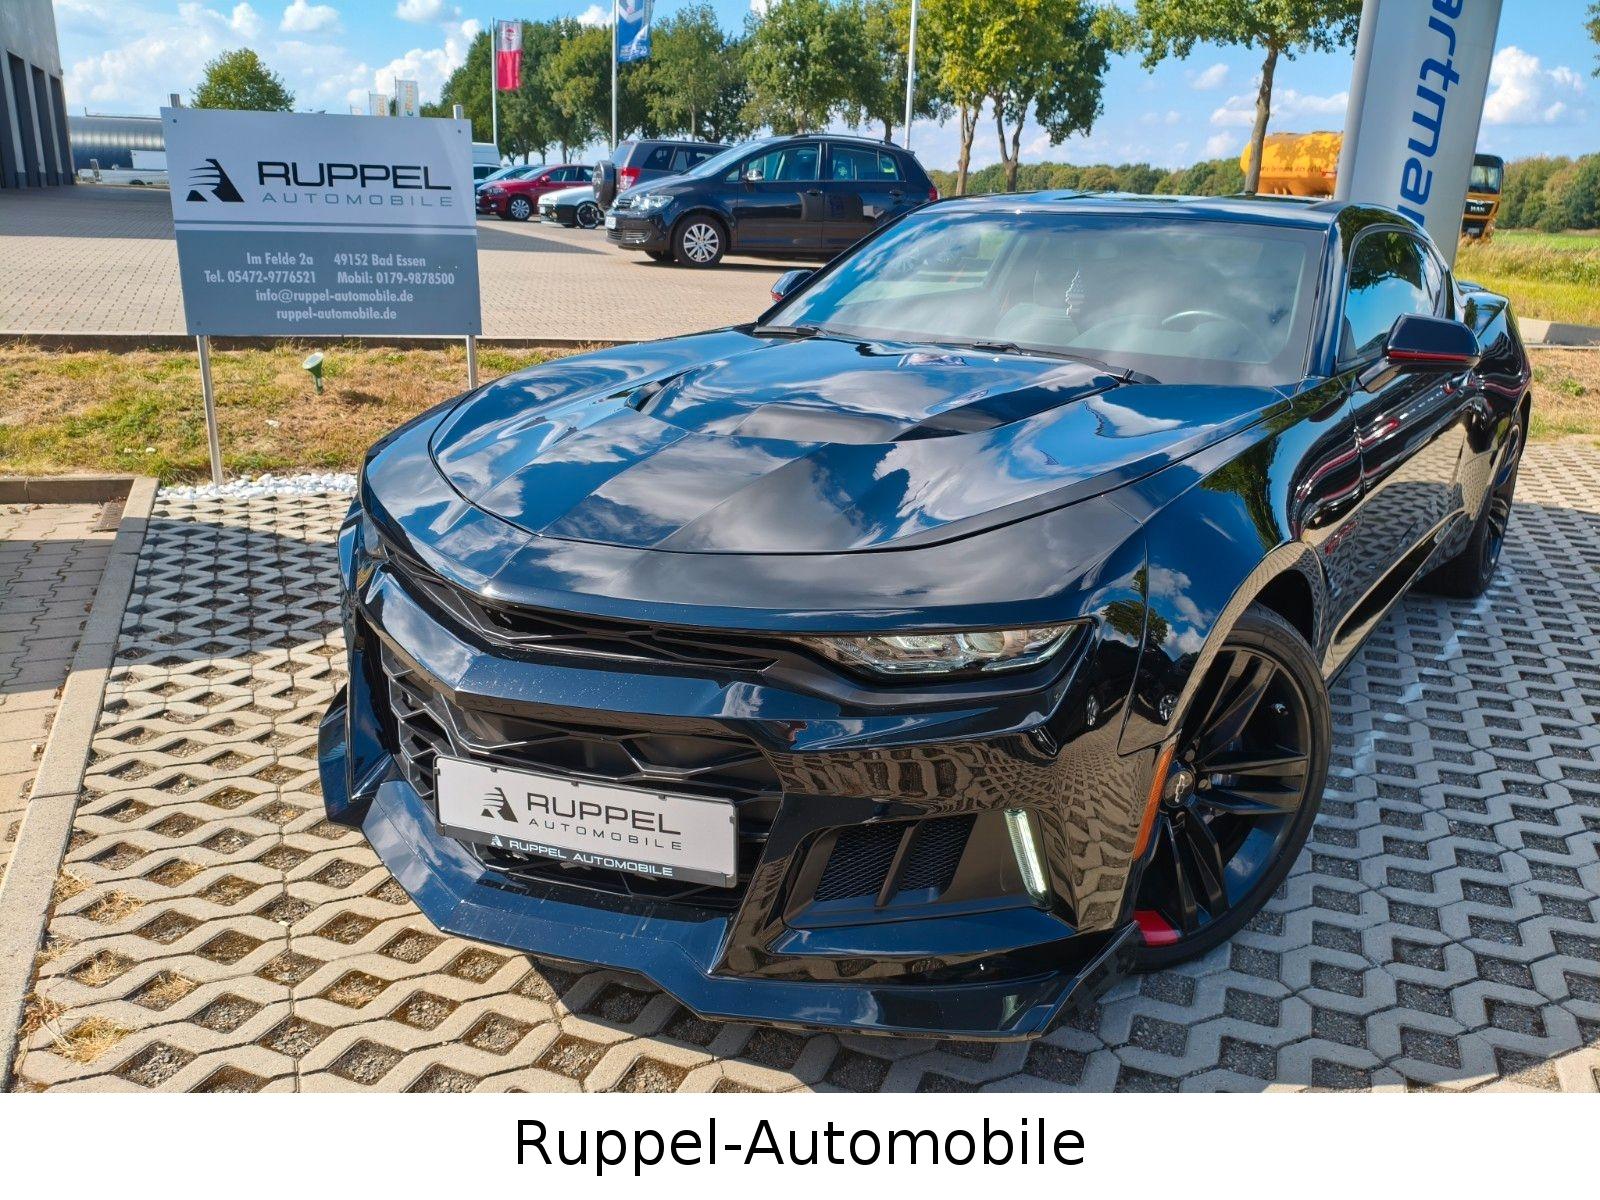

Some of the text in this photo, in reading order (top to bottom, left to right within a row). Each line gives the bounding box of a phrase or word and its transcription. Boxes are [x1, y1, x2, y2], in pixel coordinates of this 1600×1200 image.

[257, 161, 452, 190] RUPPEL
[262, 192, 453, 207] AUTOMOBILE
[246, 252, 426, 267] Im Felde 2a 49152 Bad Essen
[204, 269, 455, 284] Tel. 05472-9776521 Mobil: 0179-9878500
[255, 288, 414, 304] info@ruppel-automobile.de
[276, 306, 397, 322] ruppel-automobile.de
[526, 792, 682, 835] RUPPEL
[528, 818, 683, 851] AUTOMOBILE
[509, 839, 674, 877] RUPPEL AUTOMOBILE
